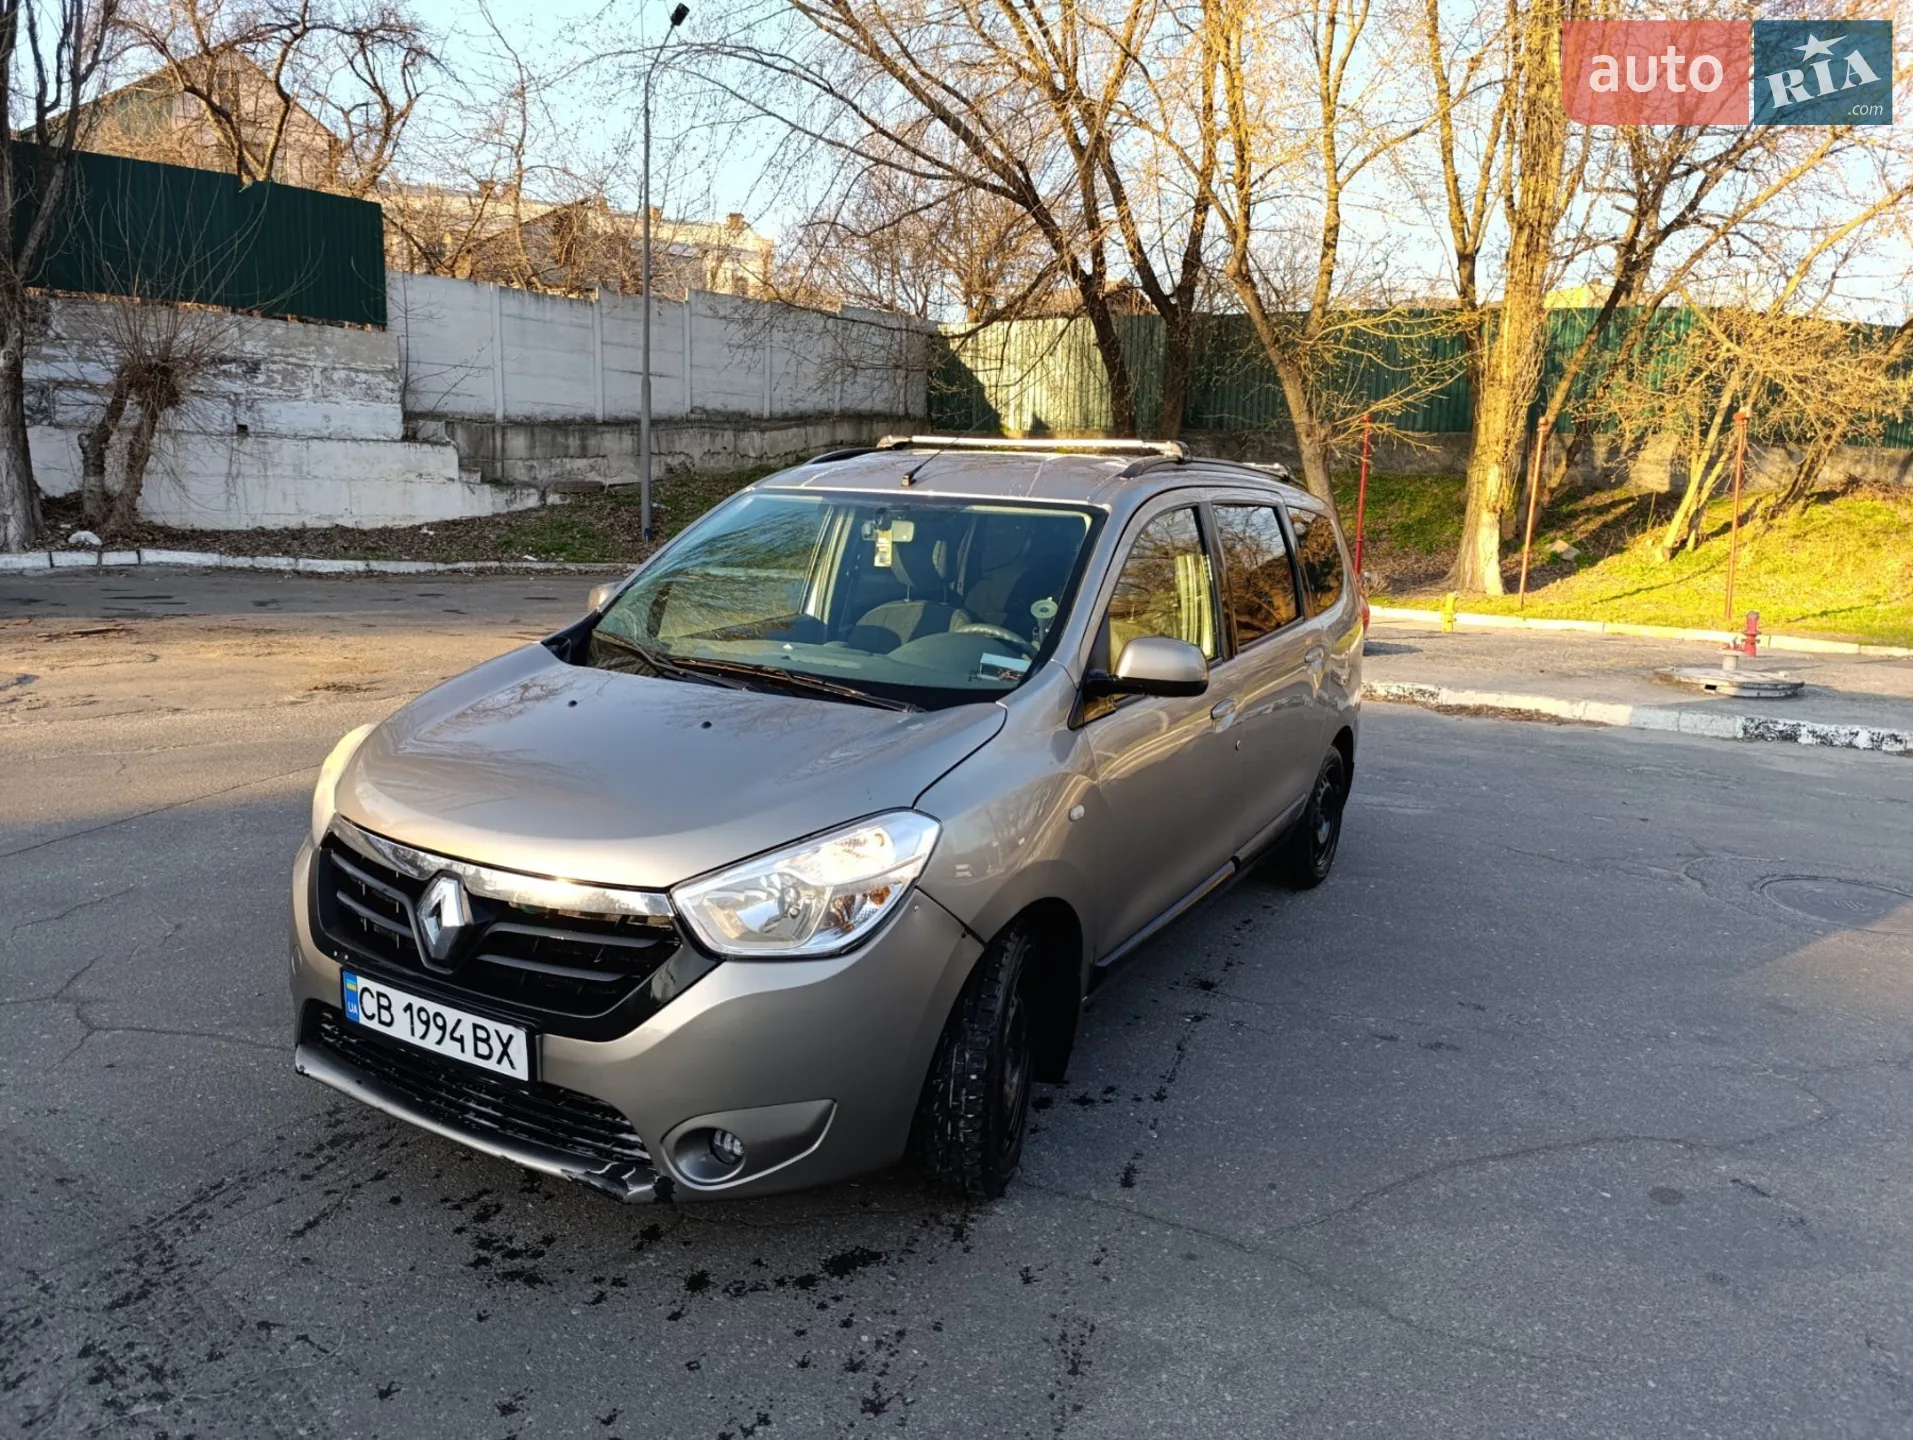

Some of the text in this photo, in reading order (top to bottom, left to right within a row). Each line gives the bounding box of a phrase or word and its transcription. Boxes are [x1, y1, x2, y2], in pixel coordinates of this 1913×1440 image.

[347, 1001, 358, 1014] UA
[359, 986, 517, 1070] CB 1994 BX
